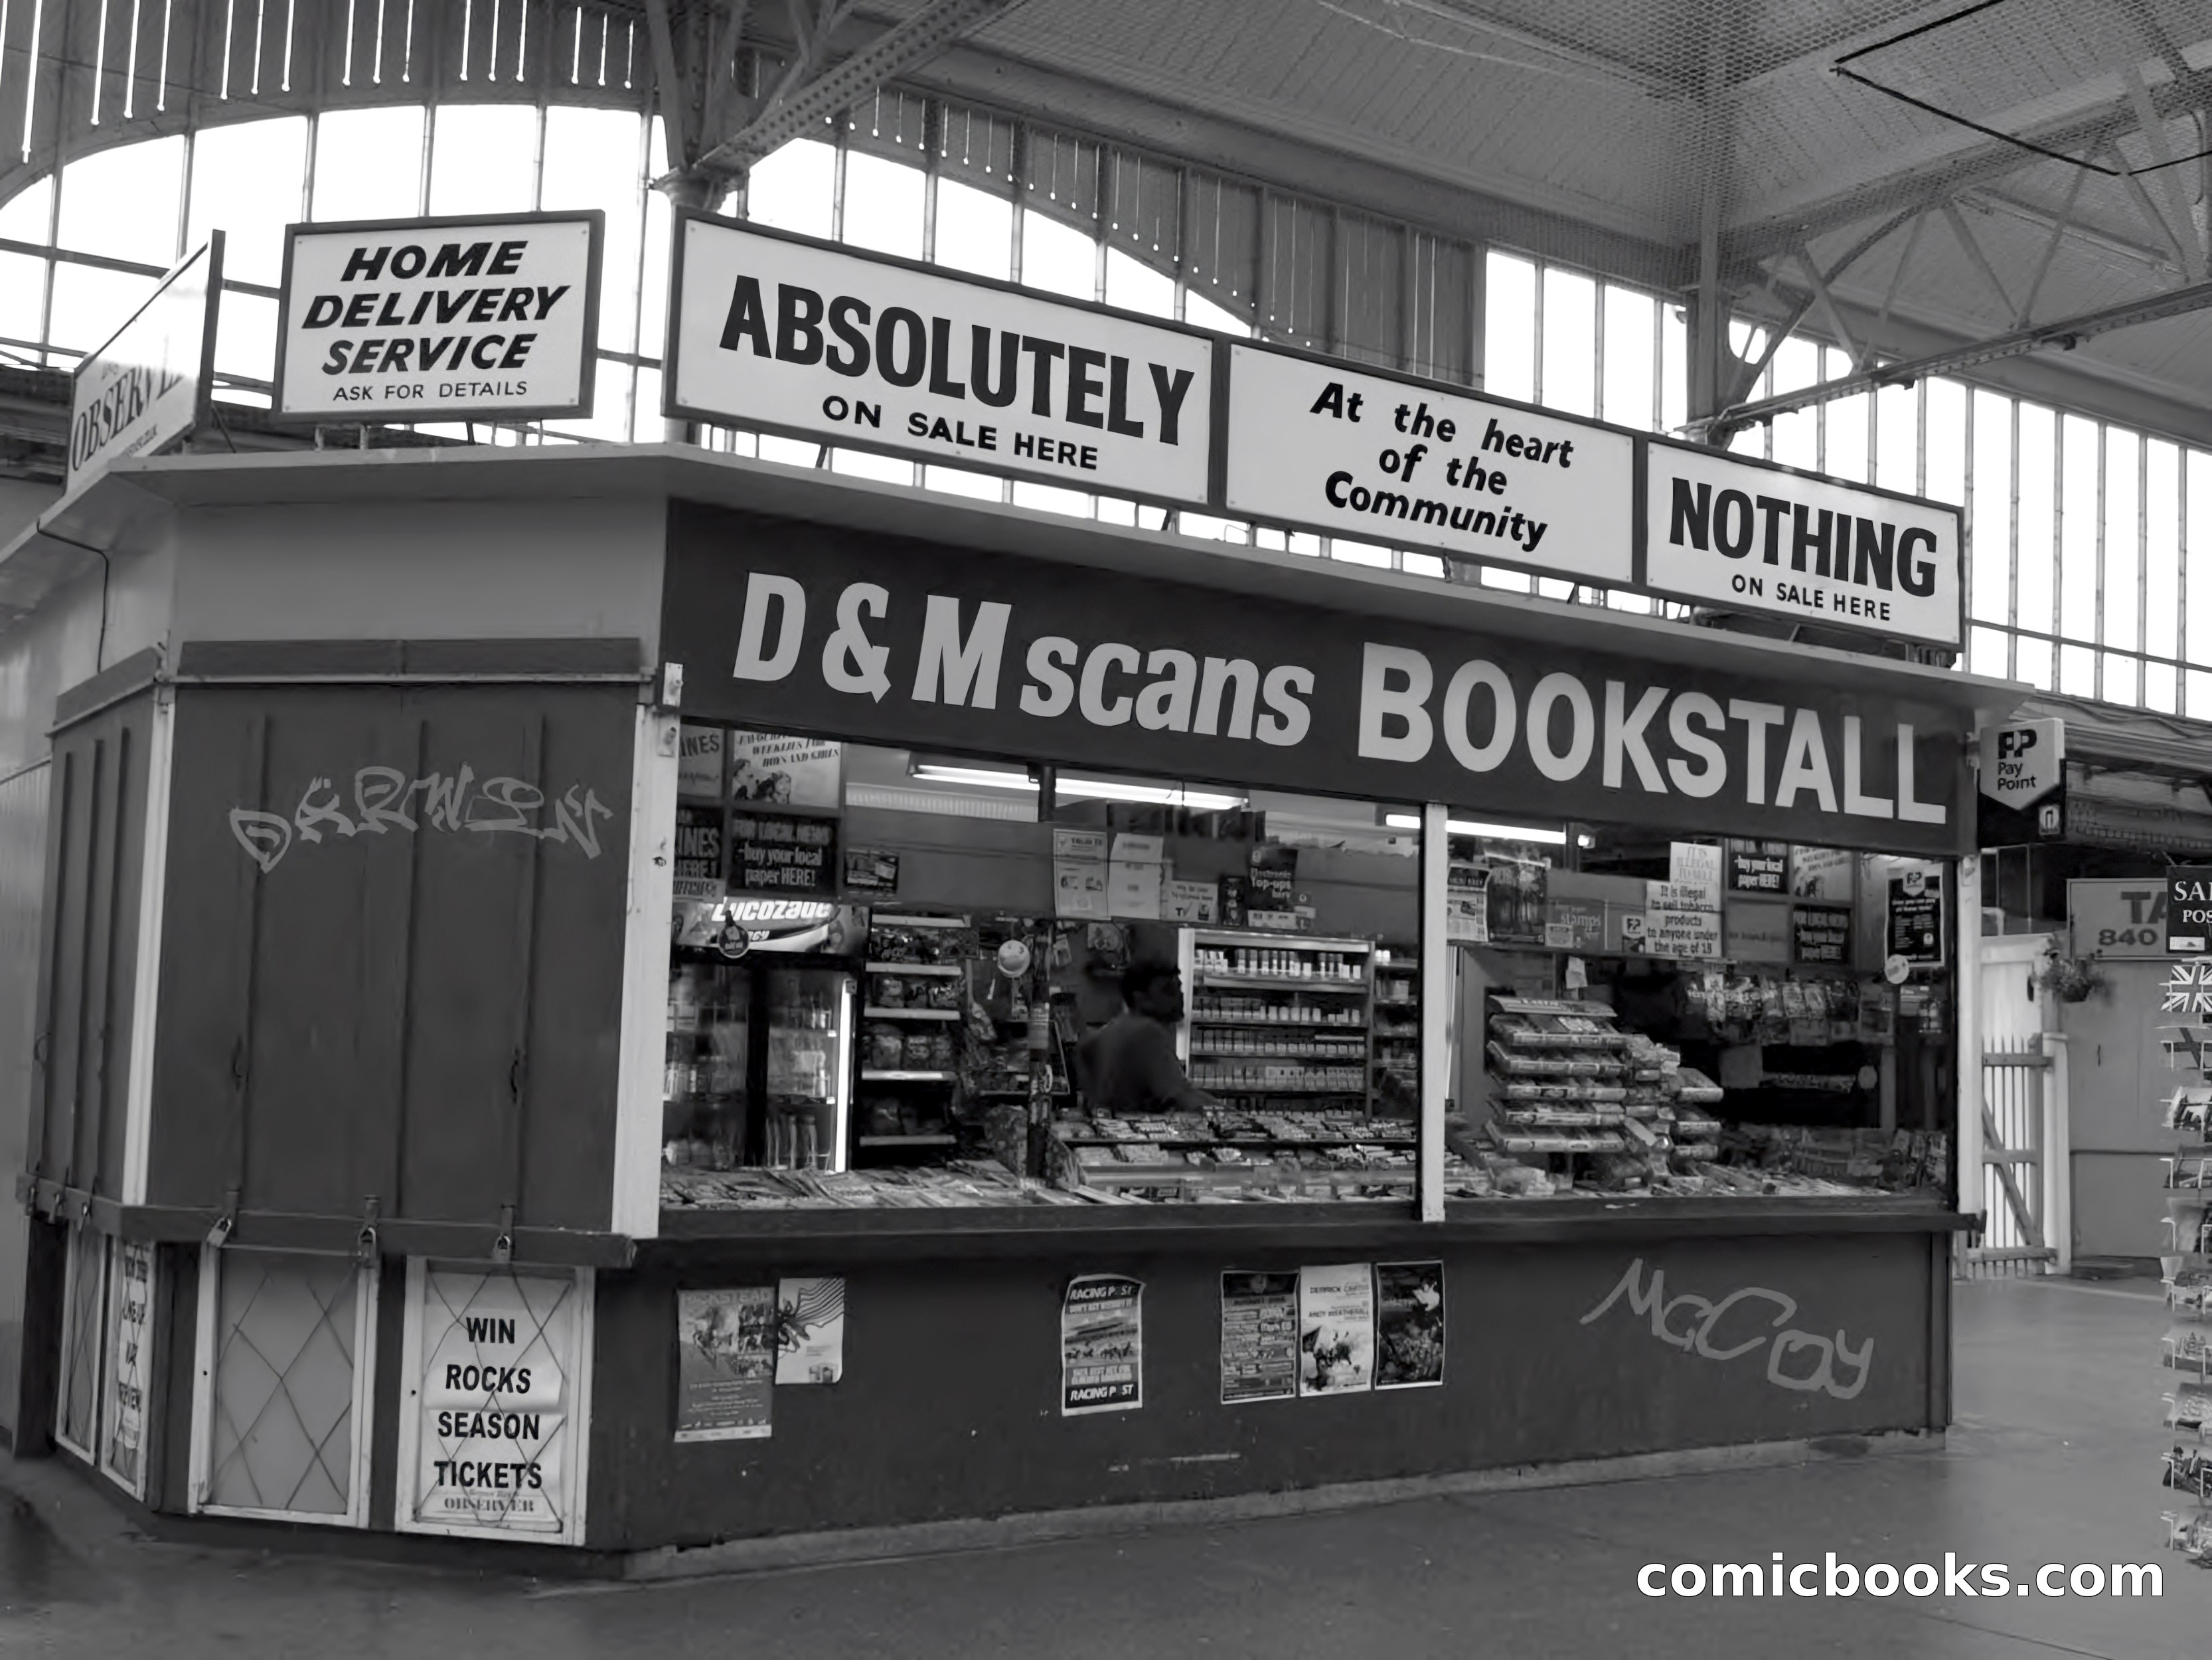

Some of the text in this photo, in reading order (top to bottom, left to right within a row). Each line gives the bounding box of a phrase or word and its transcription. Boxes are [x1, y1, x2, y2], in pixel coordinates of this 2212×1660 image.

[341, 240, 528, 282] HOME
[301, 286, 572, 329] DELIVERY
[321, 333, 538, 376] SERVICE
[719, 274, 1196, 446] ABSOLUTELY
[333, 380, 528, 402] ASK FOR DETAILS
[823, 395, 1098, 470] ON SALE HERE
[1309, 382, 1574, 469] At the heart
[1379, 442, 1508, 496] of the
[1325, 470, 1548, 552] Community
[1669, 476, 1938, 598] NOTHING
[1731, 573, 1891, 622] ON SALE HERE
[732, 571, 1947, 825] D & M scans BOOKSTALL
[1997, 776, 2037, 791] Point
[1998, 762, 2024, 778] Pay
[795, 846, 823, 866] local
[2098, 928, 2158, 946] 840
[1069, 1285, 1133, 1300] RACING PST
[465, 1317, 515, 1345] WIN
[445, 1364, 532, 1394] ROCKS
[1070, 1384, 1134, 1402] RACING PST
[437, 1411, 540, 1440] SEASON
[434, 1460, 543, 1489] TICKETS
